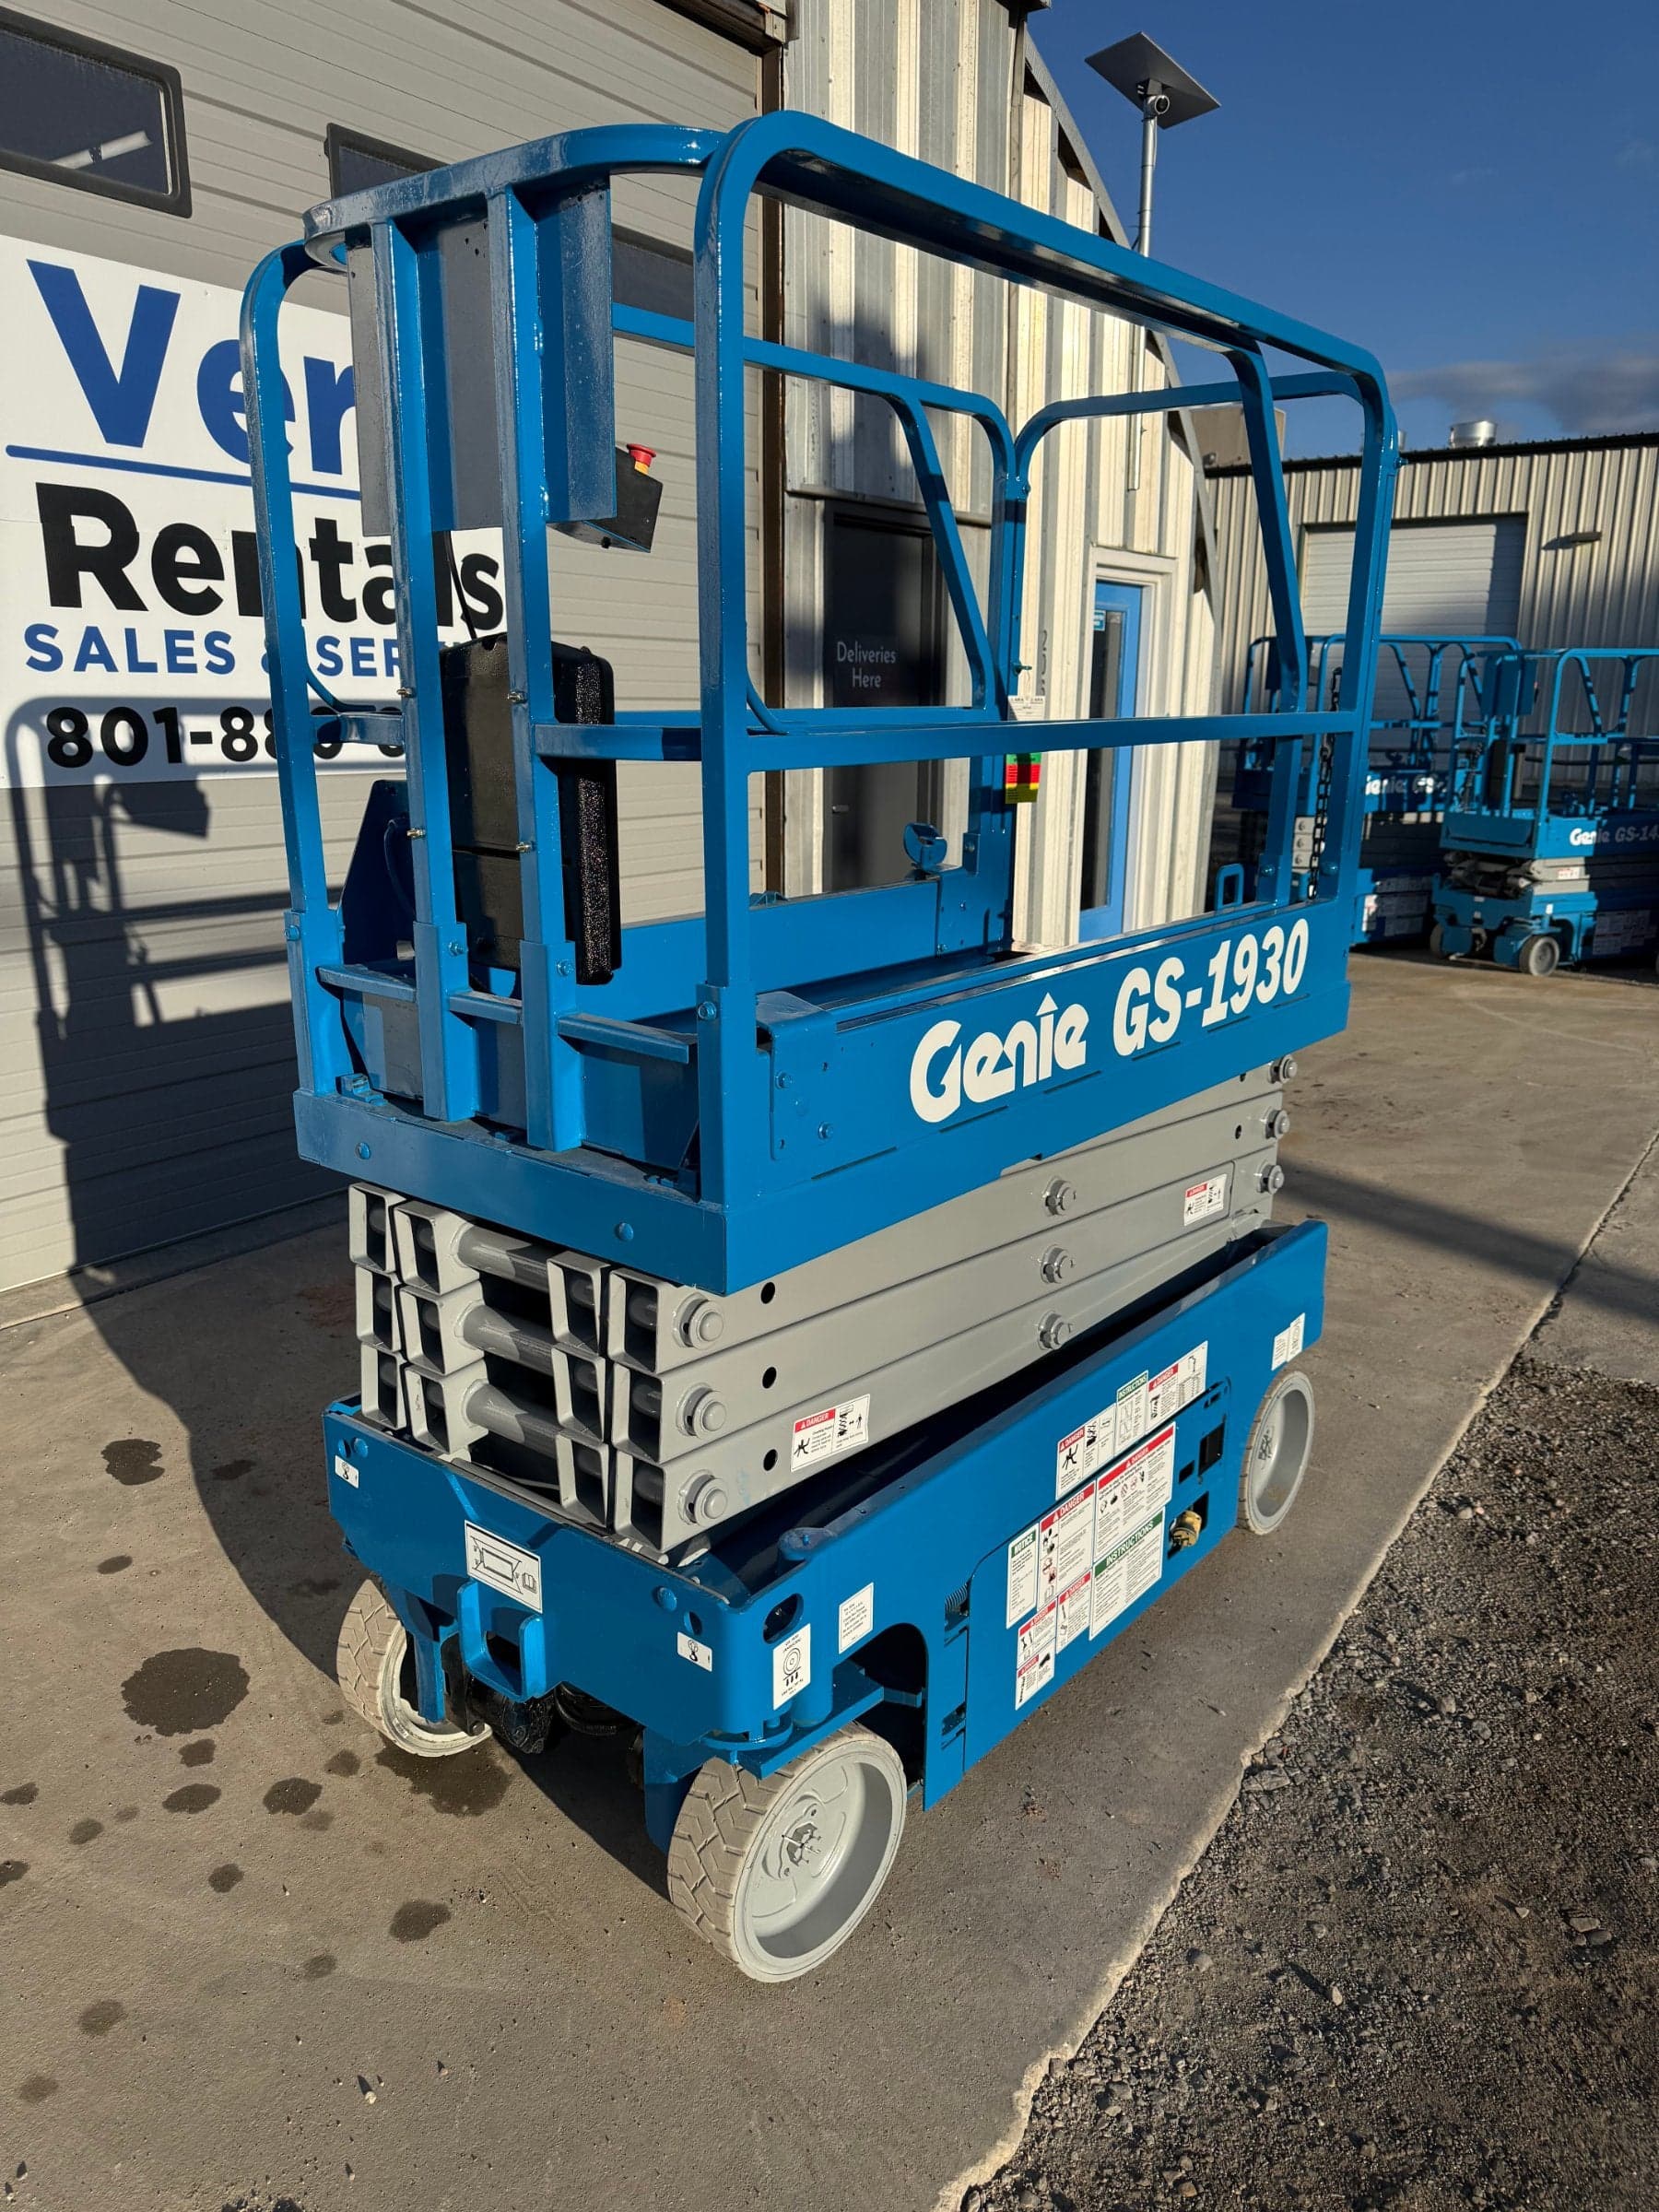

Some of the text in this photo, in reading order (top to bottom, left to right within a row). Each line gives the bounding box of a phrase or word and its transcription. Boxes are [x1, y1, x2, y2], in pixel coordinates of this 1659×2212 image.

[24, 622, 236, 676] SALES
[836, 640, 897, 665] Deliveries
[851, 671, 882, 689] Here
[1569, 824, 1659, 847] Genie GS-14
[909, 917, 1311, 1124] Genie GS-1930
[806, 1412, 830, 1427] DANGER
[1059, 1491, 1086, 1518] DANGER
[1013, 1533, 1034, 1556] NOTICE
[1105, 1520, 1155, 1567] INSTRUCTIONS
